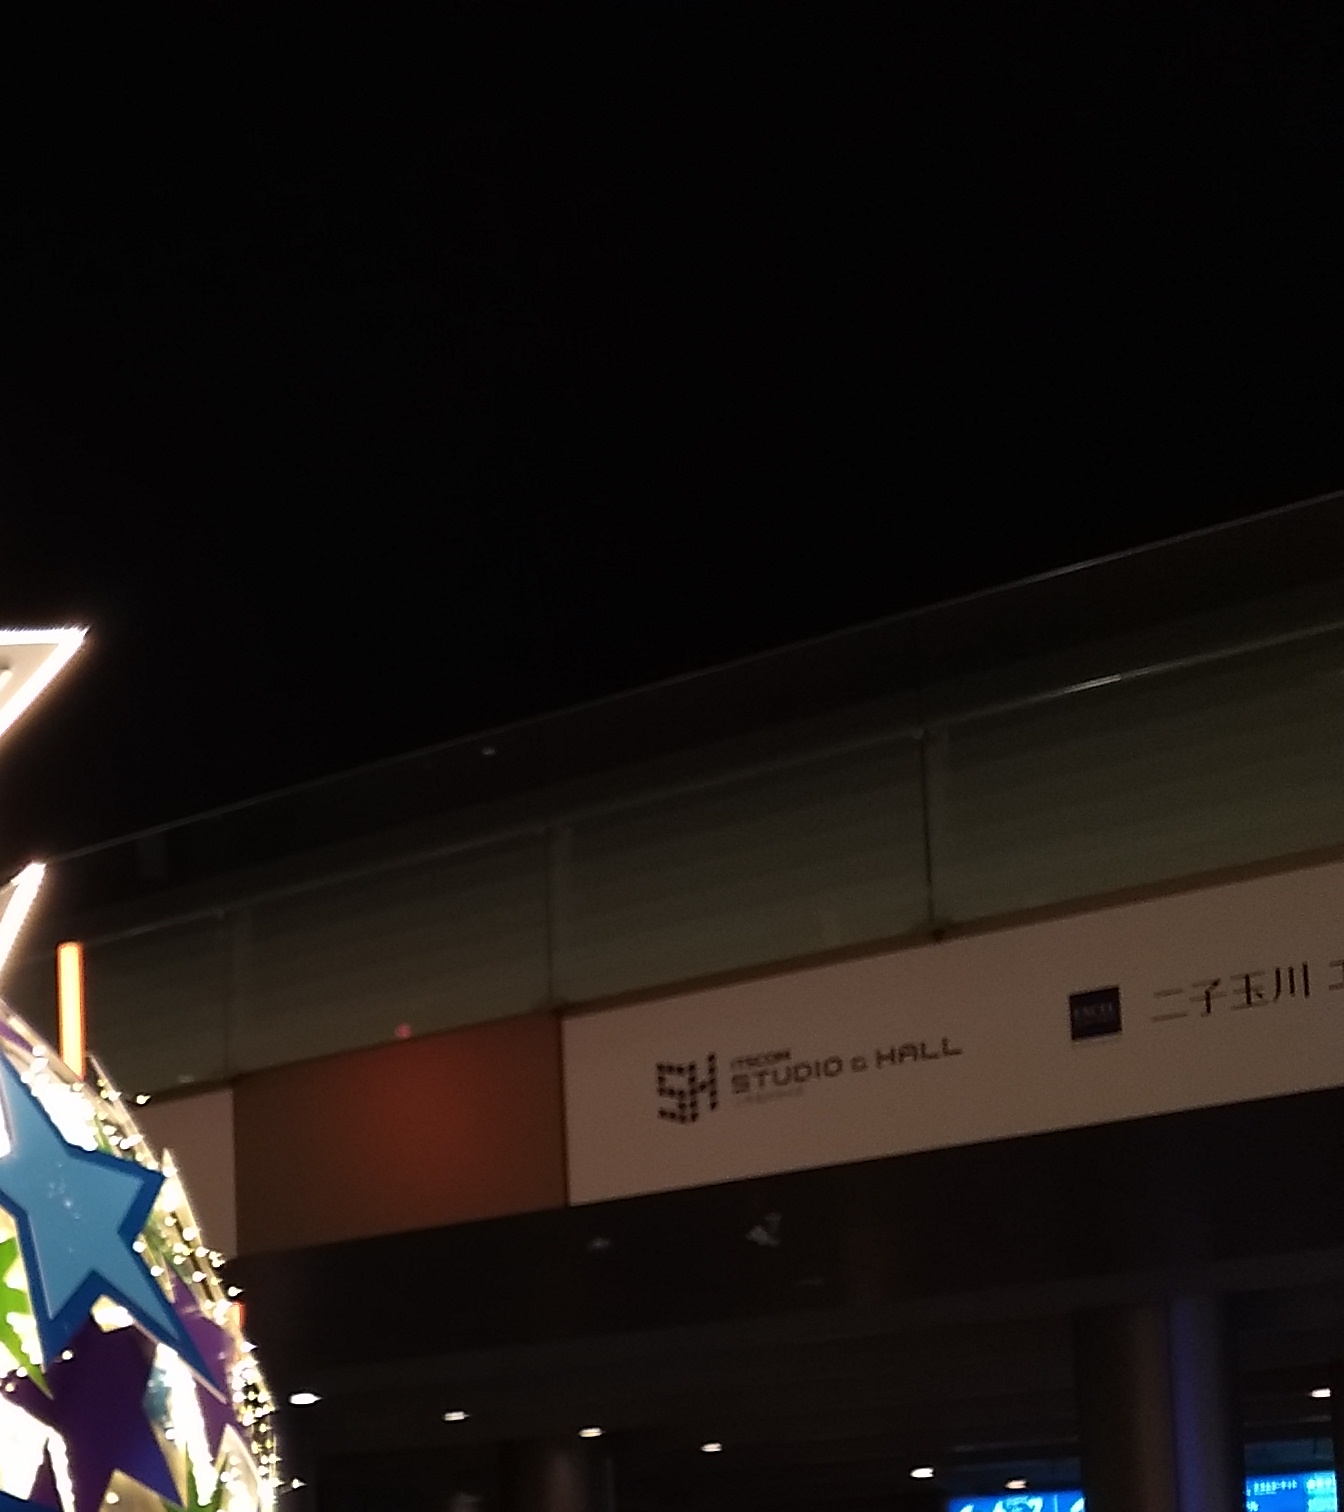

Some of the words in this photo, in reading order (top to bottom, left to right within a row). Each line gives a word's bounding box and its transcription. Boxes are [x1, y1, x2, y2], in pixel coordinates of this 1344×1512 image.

[1150, 961, 1311, 1023] 二子玉川
[731, 1056, 844, 1095] STUDIO
[875, 1036, 965, 1070] HALL
